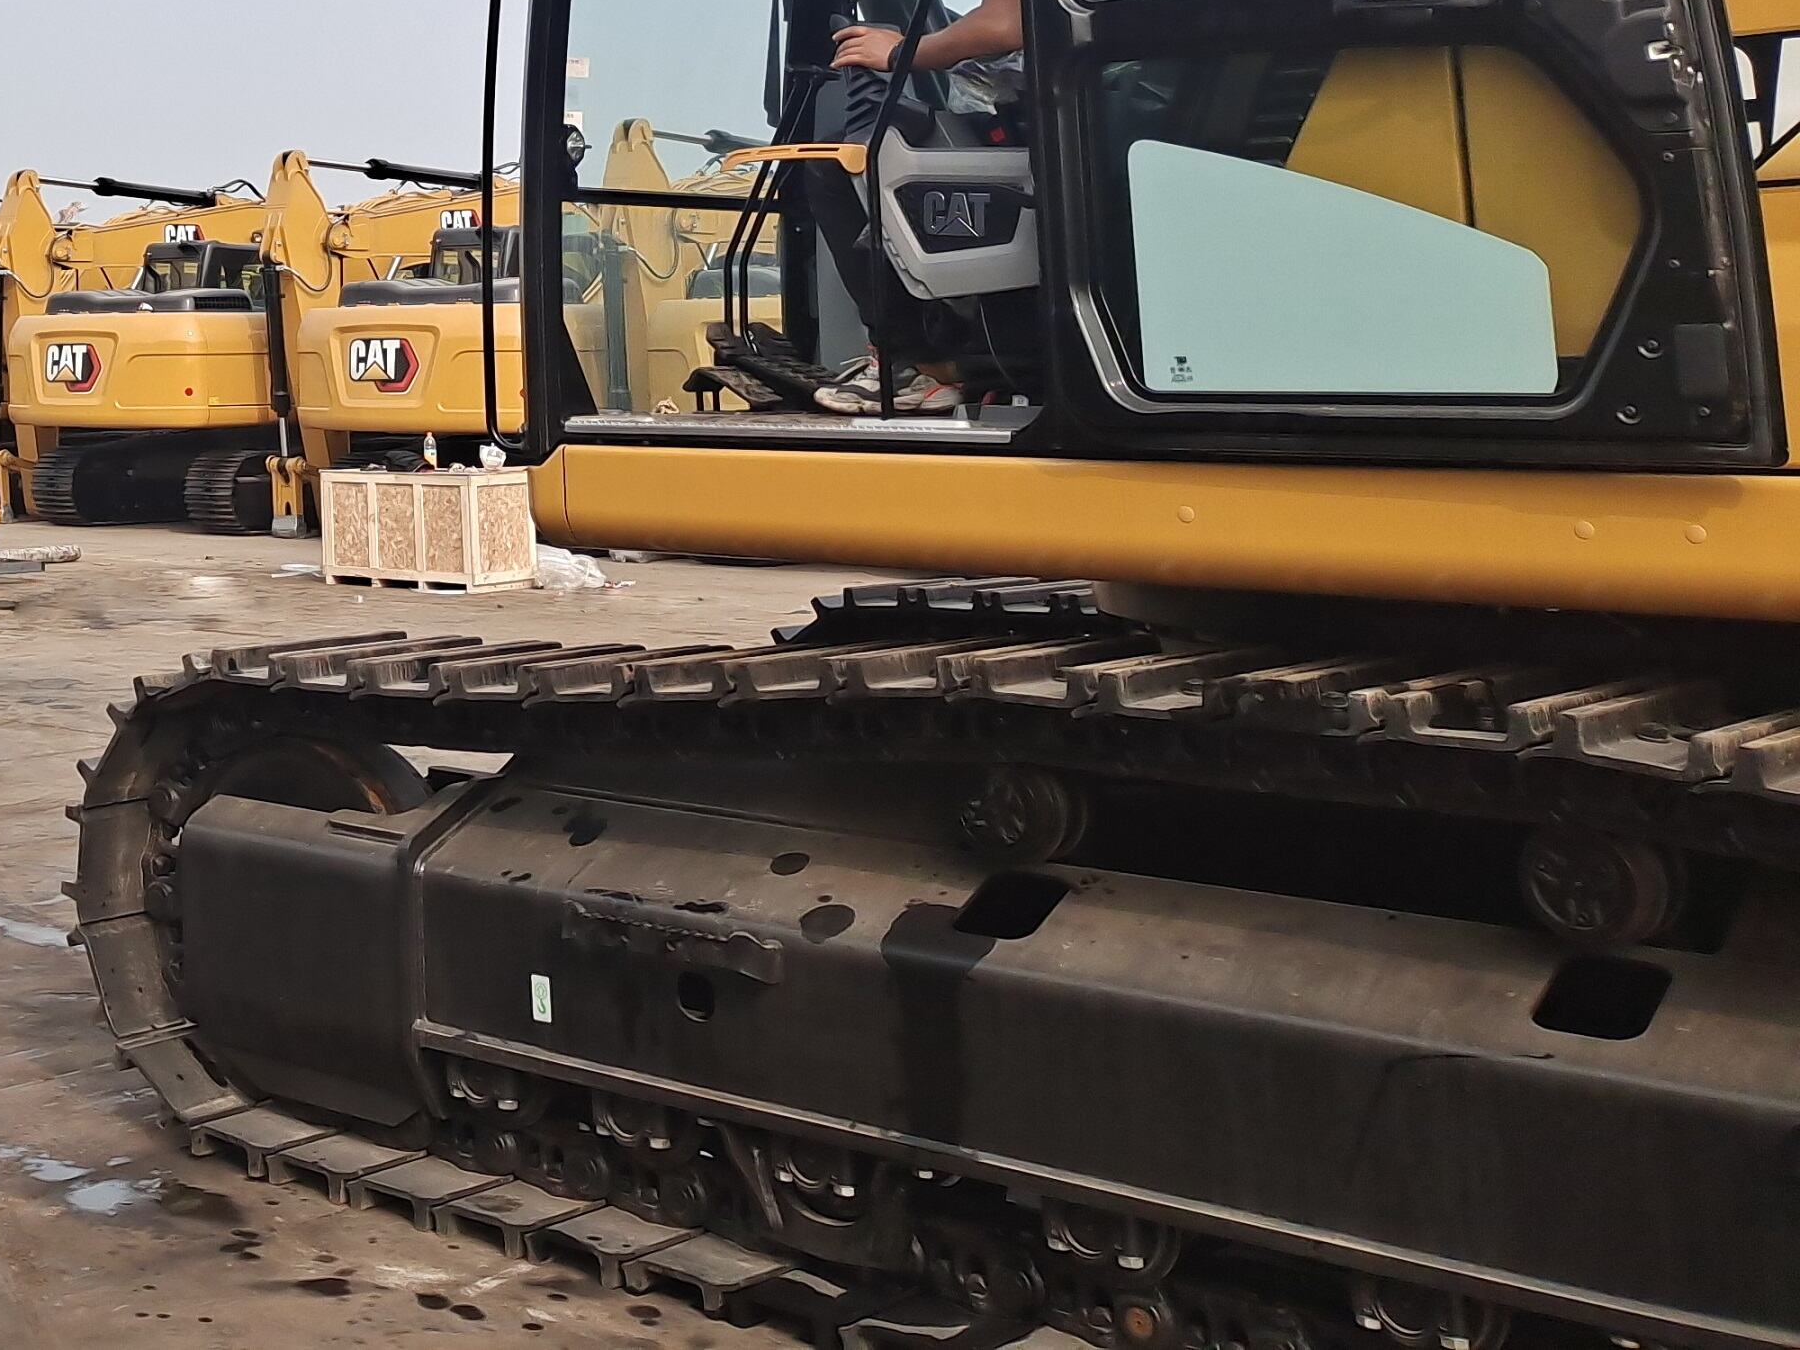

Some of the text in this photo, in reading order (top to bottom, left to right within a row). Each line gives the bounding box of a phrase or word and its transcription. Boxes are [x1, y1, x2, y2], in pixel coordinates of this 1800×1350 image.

[442, 211, 474, 229] CAT
[924, 191, 991, 237] CAT
[165, 224, 198, 243] CAT
[47, 345, 88, 382] CAT
[352, 339, 401, 381] CAT
